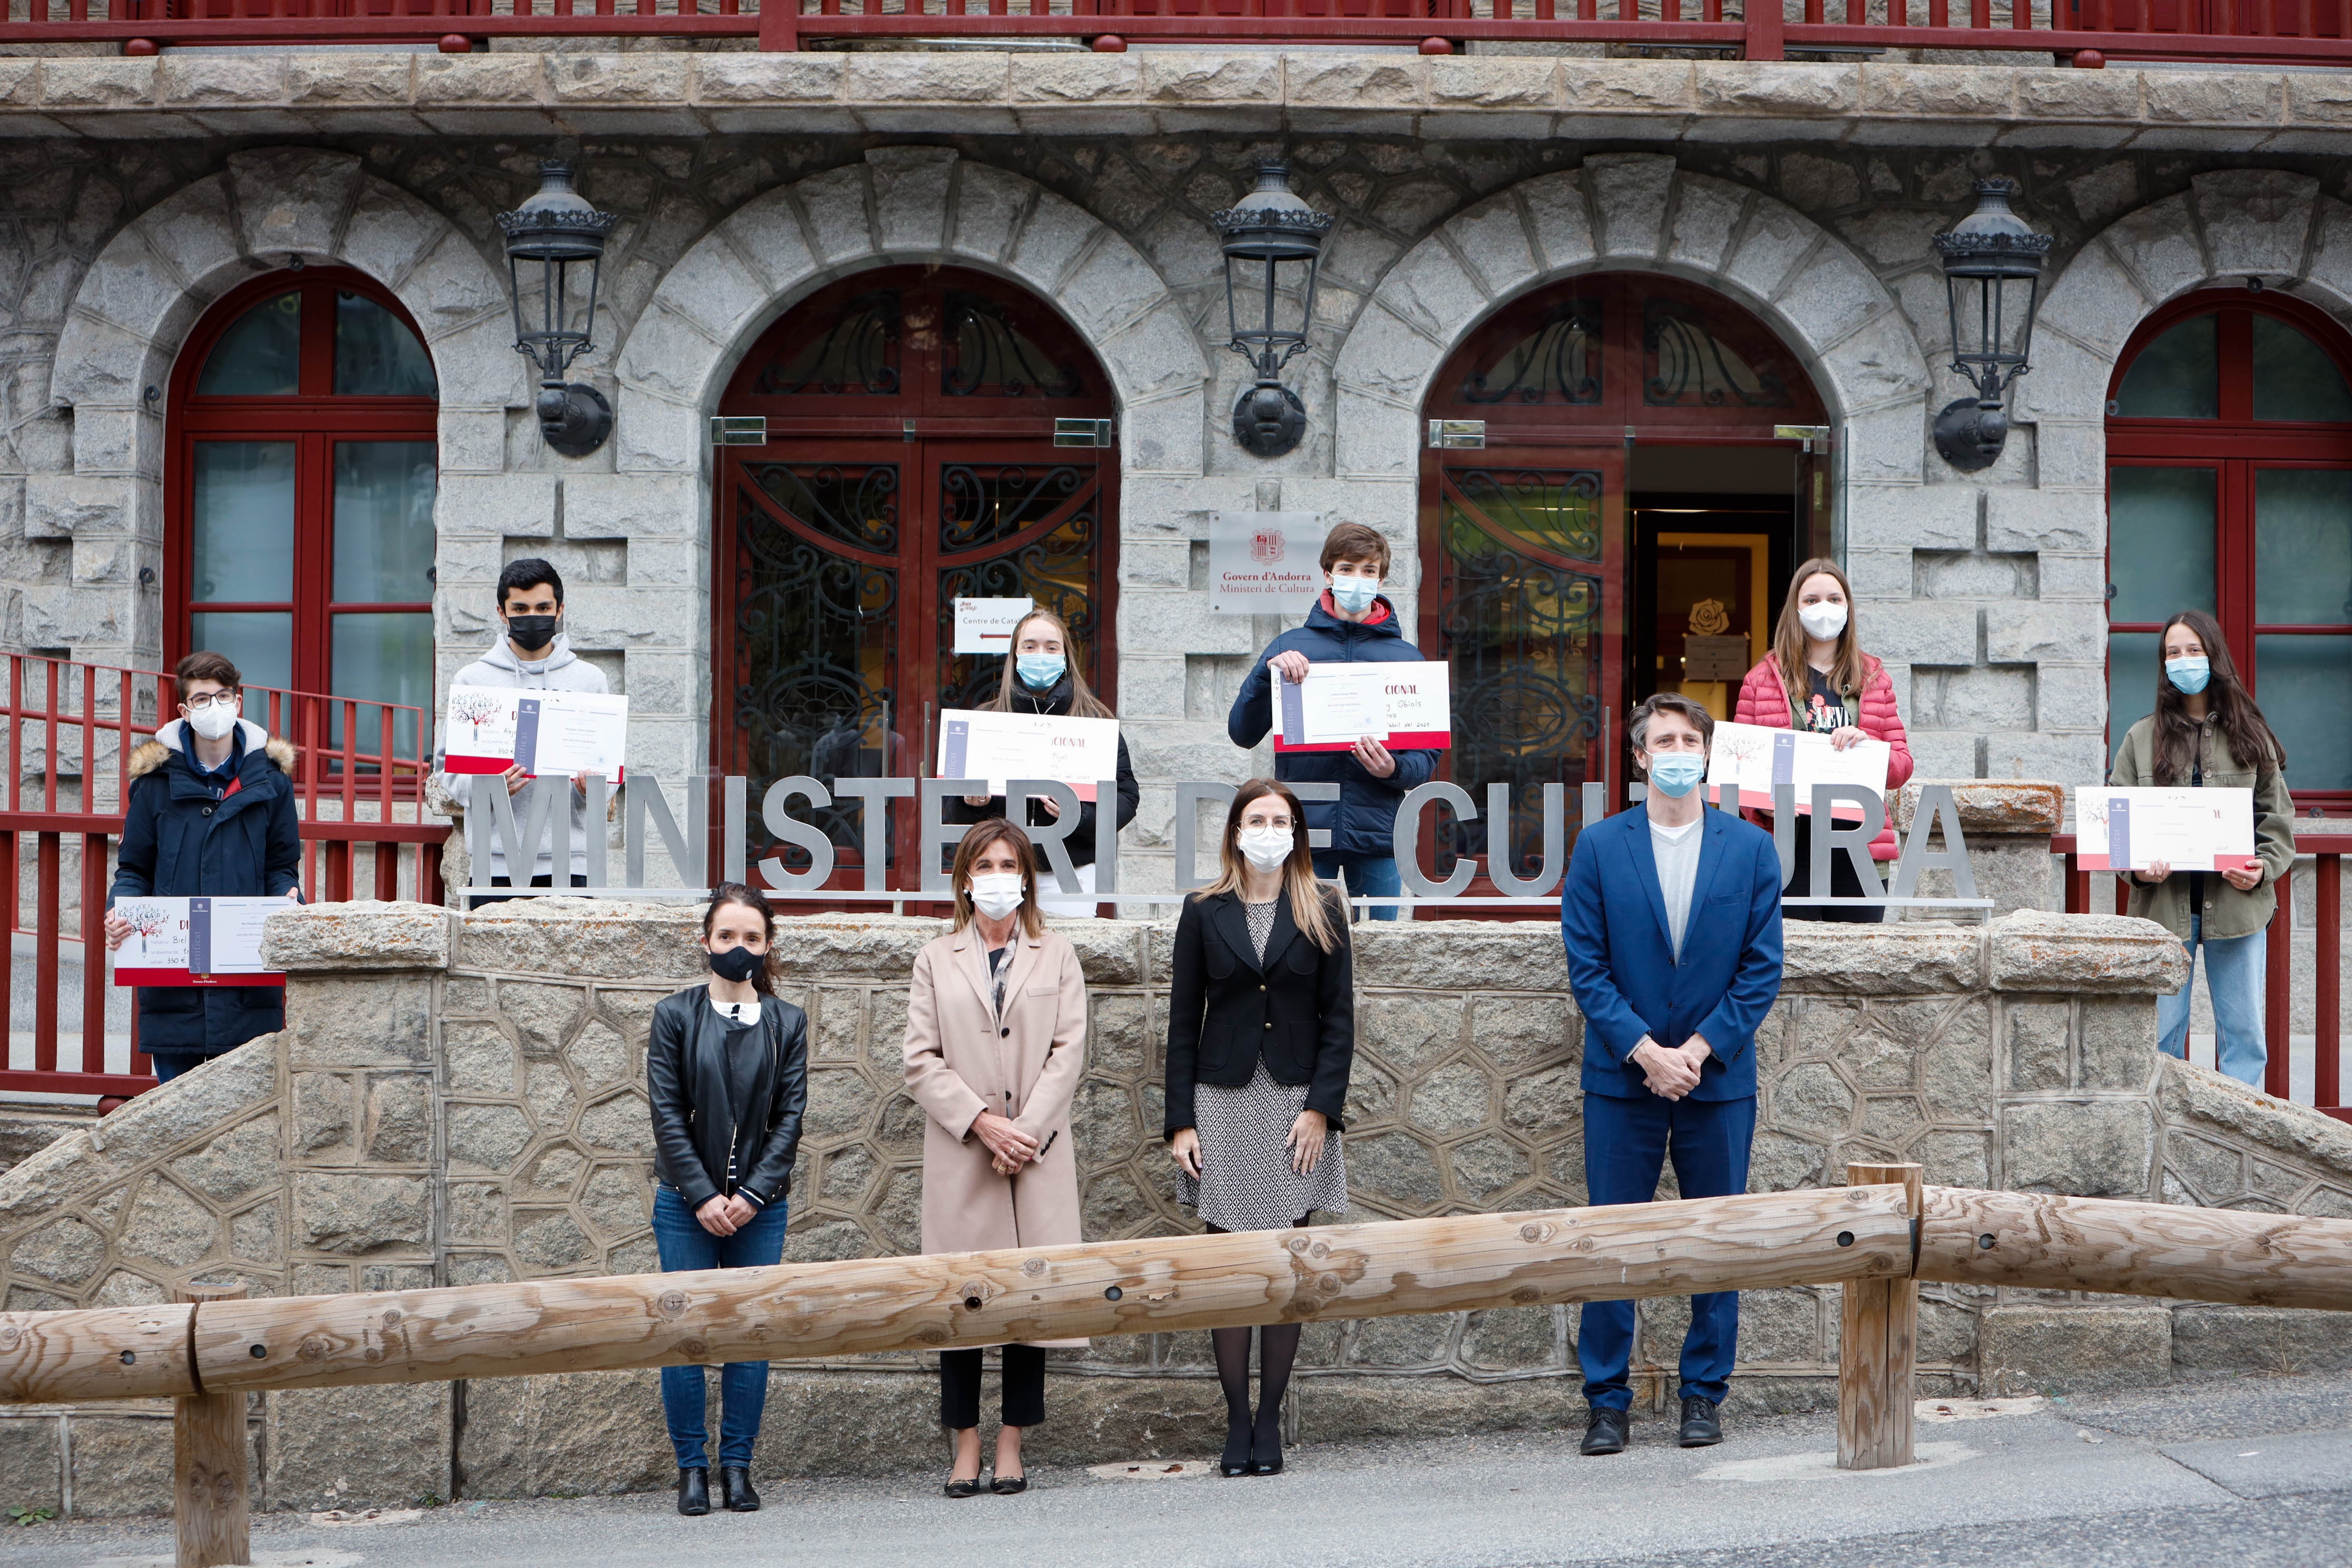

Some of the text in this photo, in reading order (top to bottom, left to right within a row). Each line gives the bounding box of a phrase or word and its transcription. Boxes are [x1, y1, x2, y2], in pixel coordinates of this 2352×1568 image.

[1223, 571, 1311, 581] Govern d'Andorra
[1220, 583, 1315, 593] Ministeri de Cultura
[1385, 684, 1420, 695] CIONAL
[1397, 699, 1422, 708] Obiols
[471, 775, 1117, 894] MINISTERI
[172, 935, 187, 944] Biel
